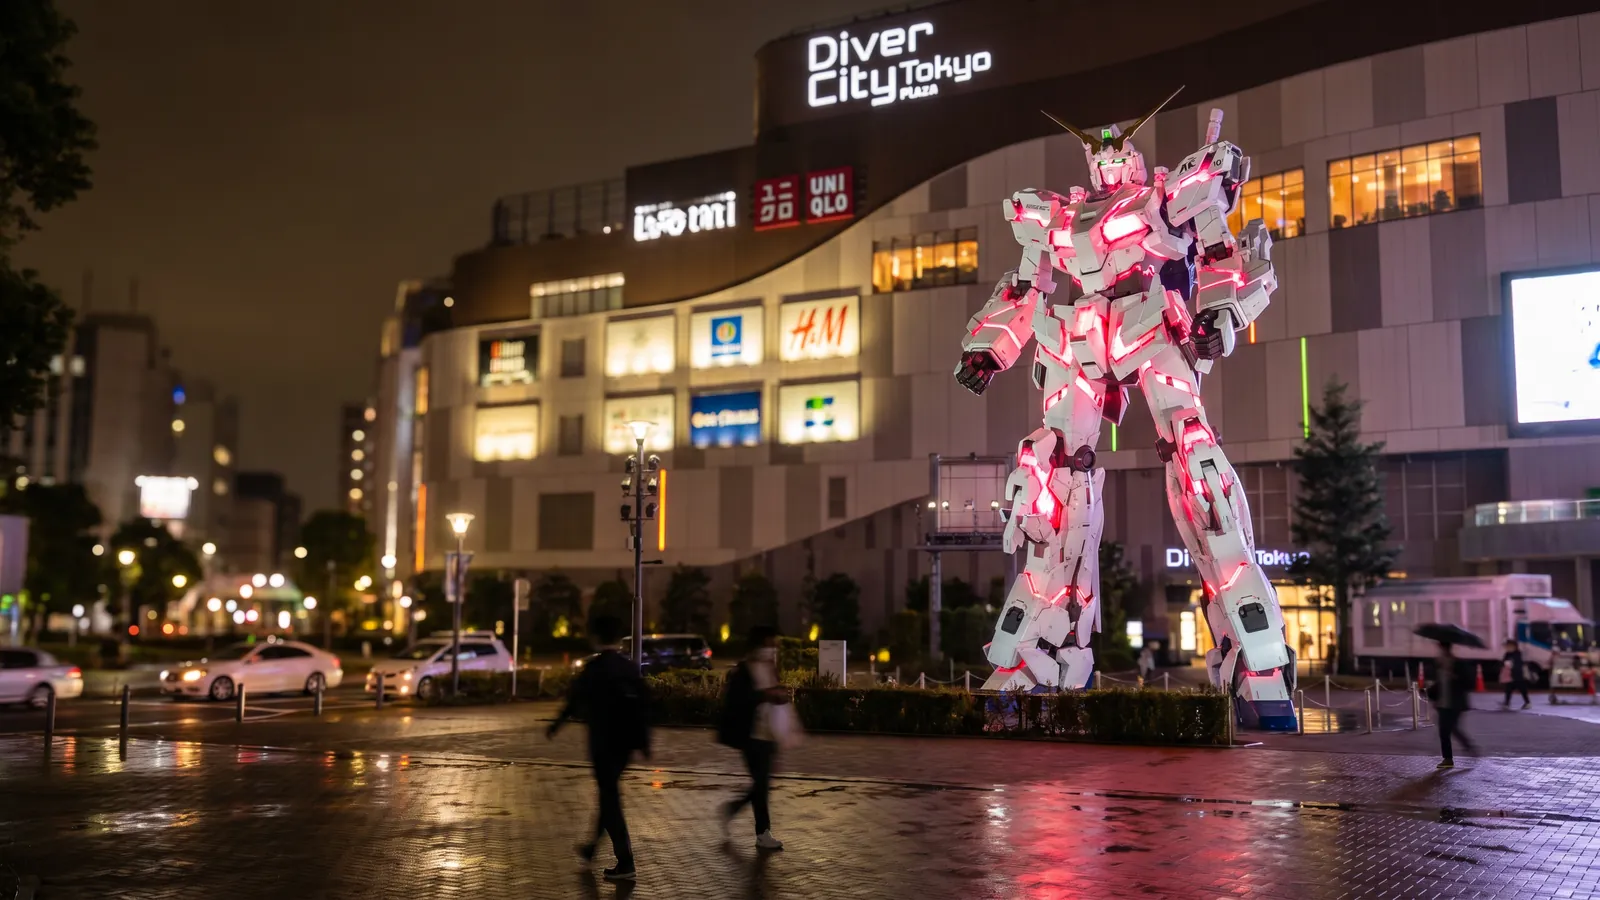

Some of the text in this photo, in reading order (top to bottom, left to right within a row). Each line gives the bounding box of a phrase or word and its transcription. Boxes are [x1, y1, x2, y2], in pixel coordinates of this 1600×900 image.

[808, 22, 934, 72] Diver
[808, 51, 992, 107] City Tokyo
[899, 84, 938, 100] PLAZA
[761, 182, 793, 202] ユニ
[810, 172, 845, 196] UNI
[761, 201, 793, 222] クロ
[810, 194, 848, 217] QLO
[790, 304, 848, 350] H&M
